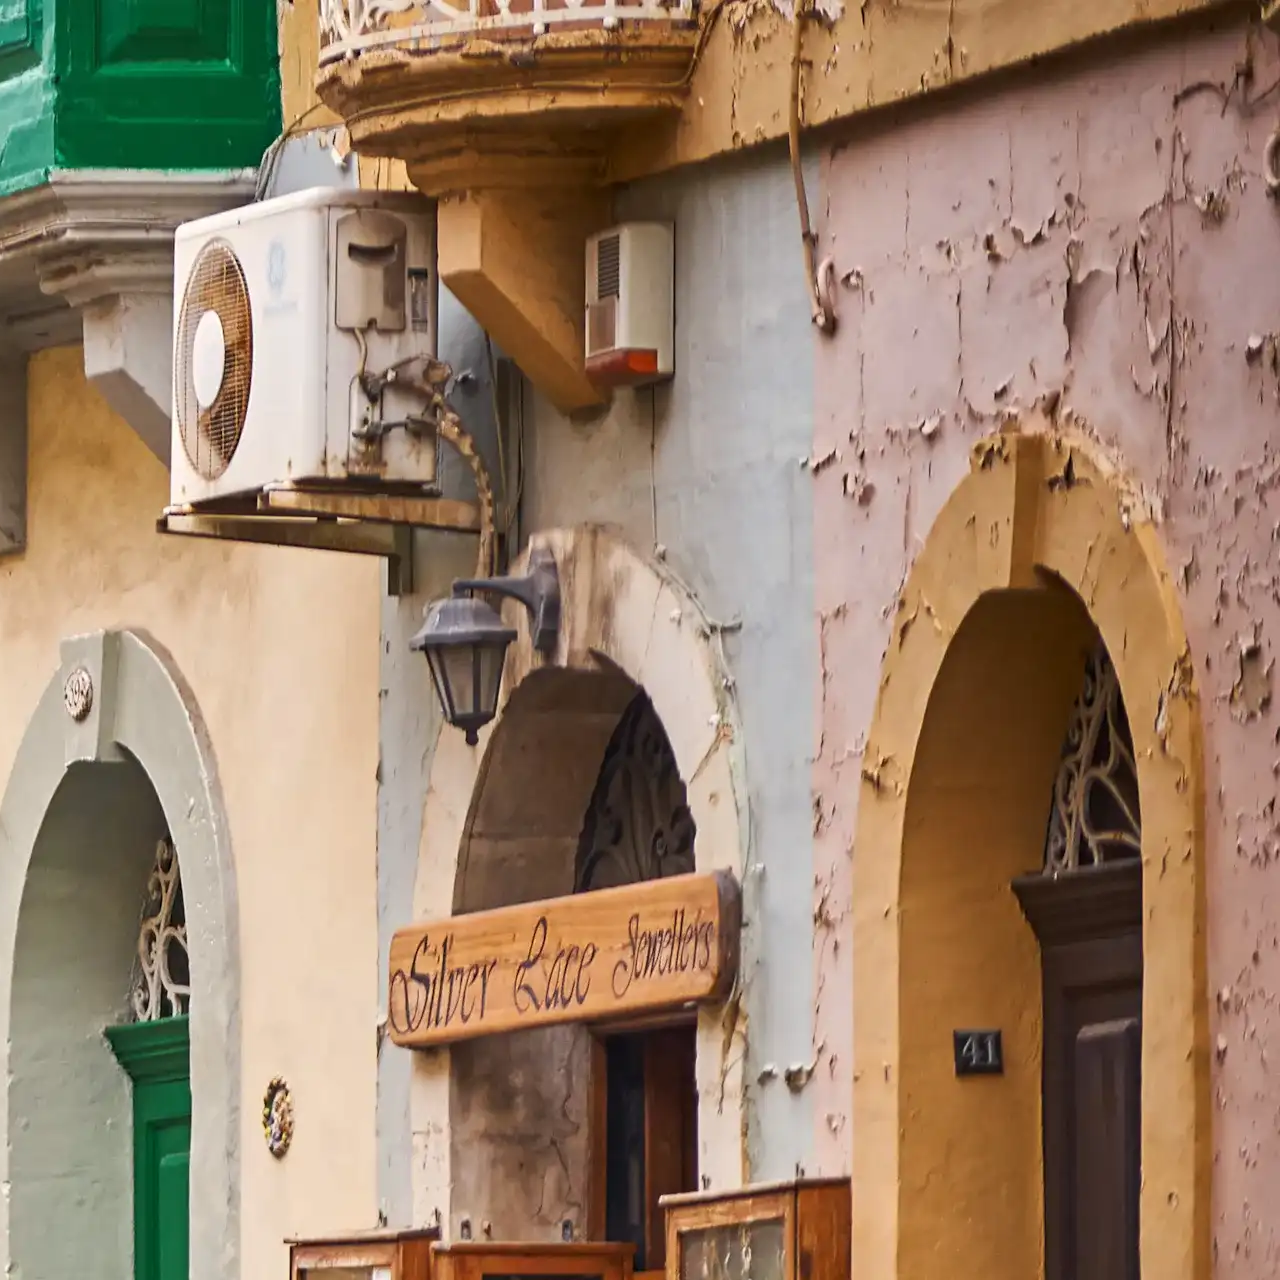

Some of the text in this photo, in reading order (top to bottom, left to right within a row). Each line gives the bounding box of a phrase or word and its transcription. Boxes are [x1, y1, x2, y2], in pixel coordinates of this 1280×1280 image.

[390, 906, 715, 1036] Silver Lace Jewellers
[962, 1034, 998, 1066] 41
